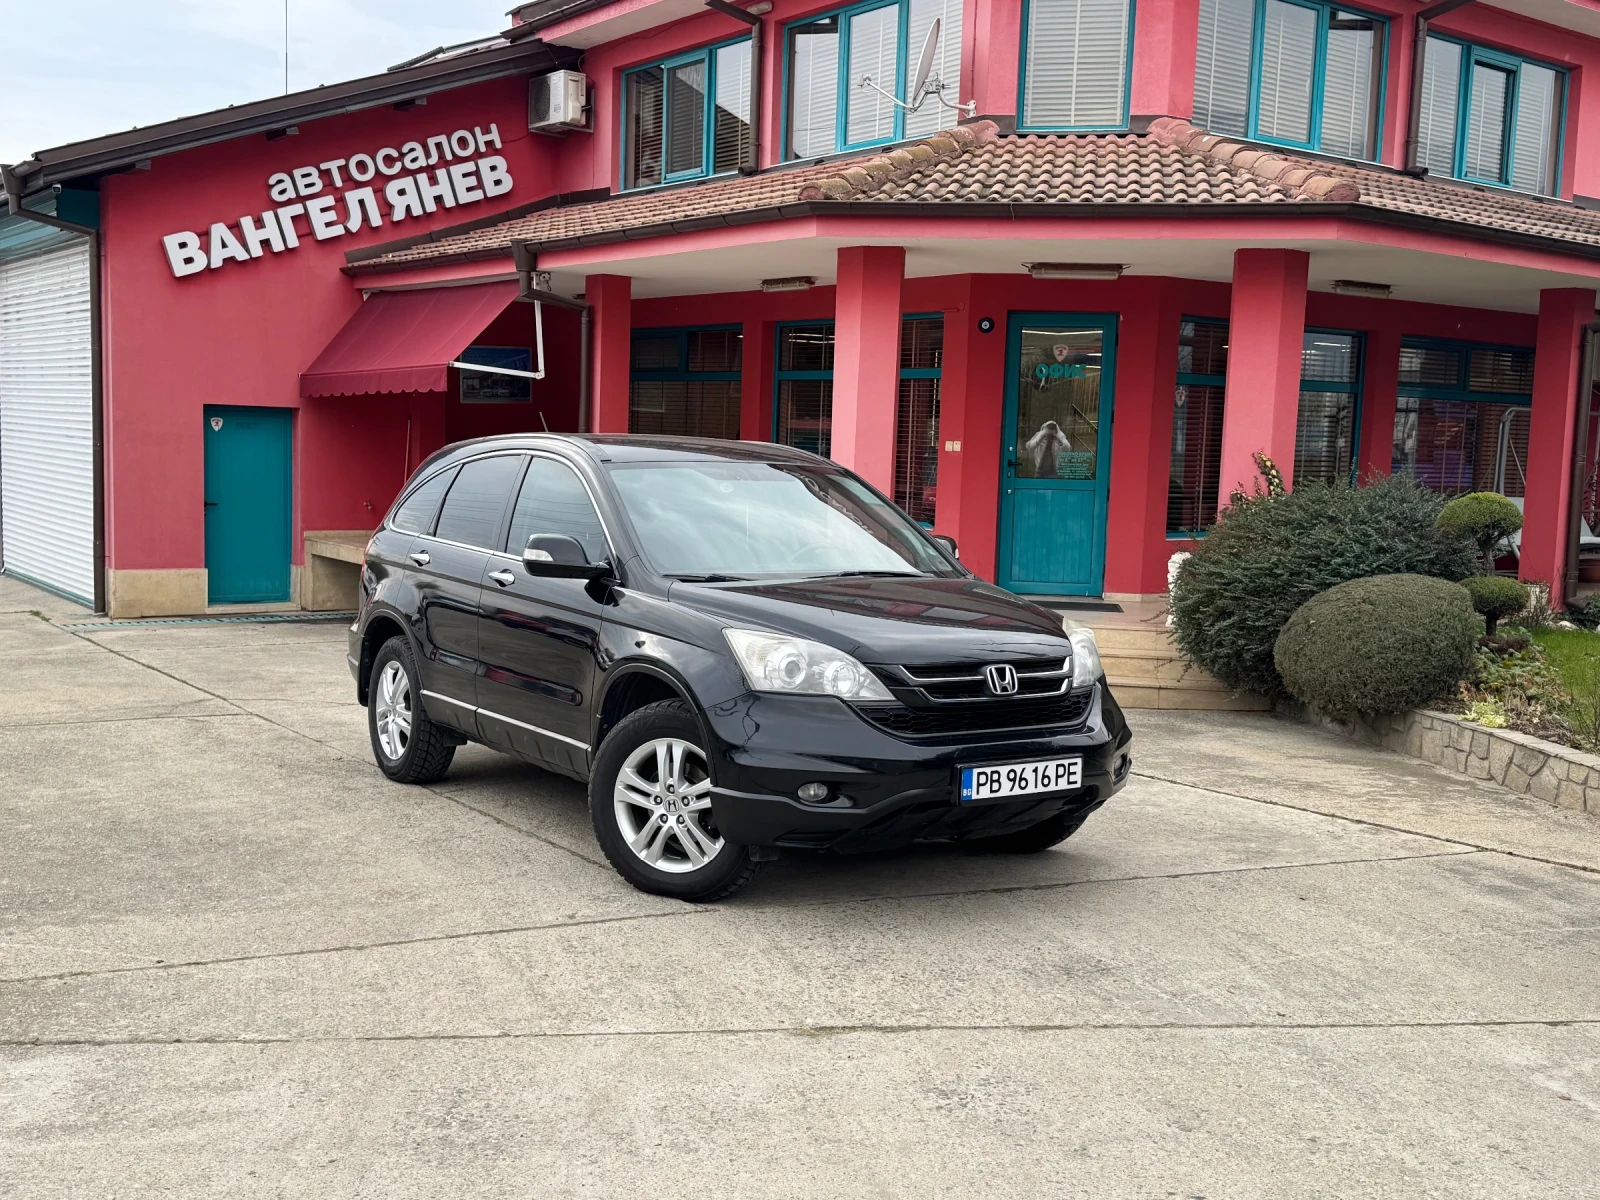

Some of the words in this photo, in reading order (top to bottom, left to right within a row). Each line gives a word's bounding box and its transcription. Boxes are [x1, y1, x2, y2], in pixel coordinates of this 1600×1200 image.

[268, 123, 503, 202] автосалон
[162, 186, 384, 278] ВАНГЕЛ
[383, 155, 514, 222] ЯНЕВ
[1035, 363, 1087, 379] ОФИС
